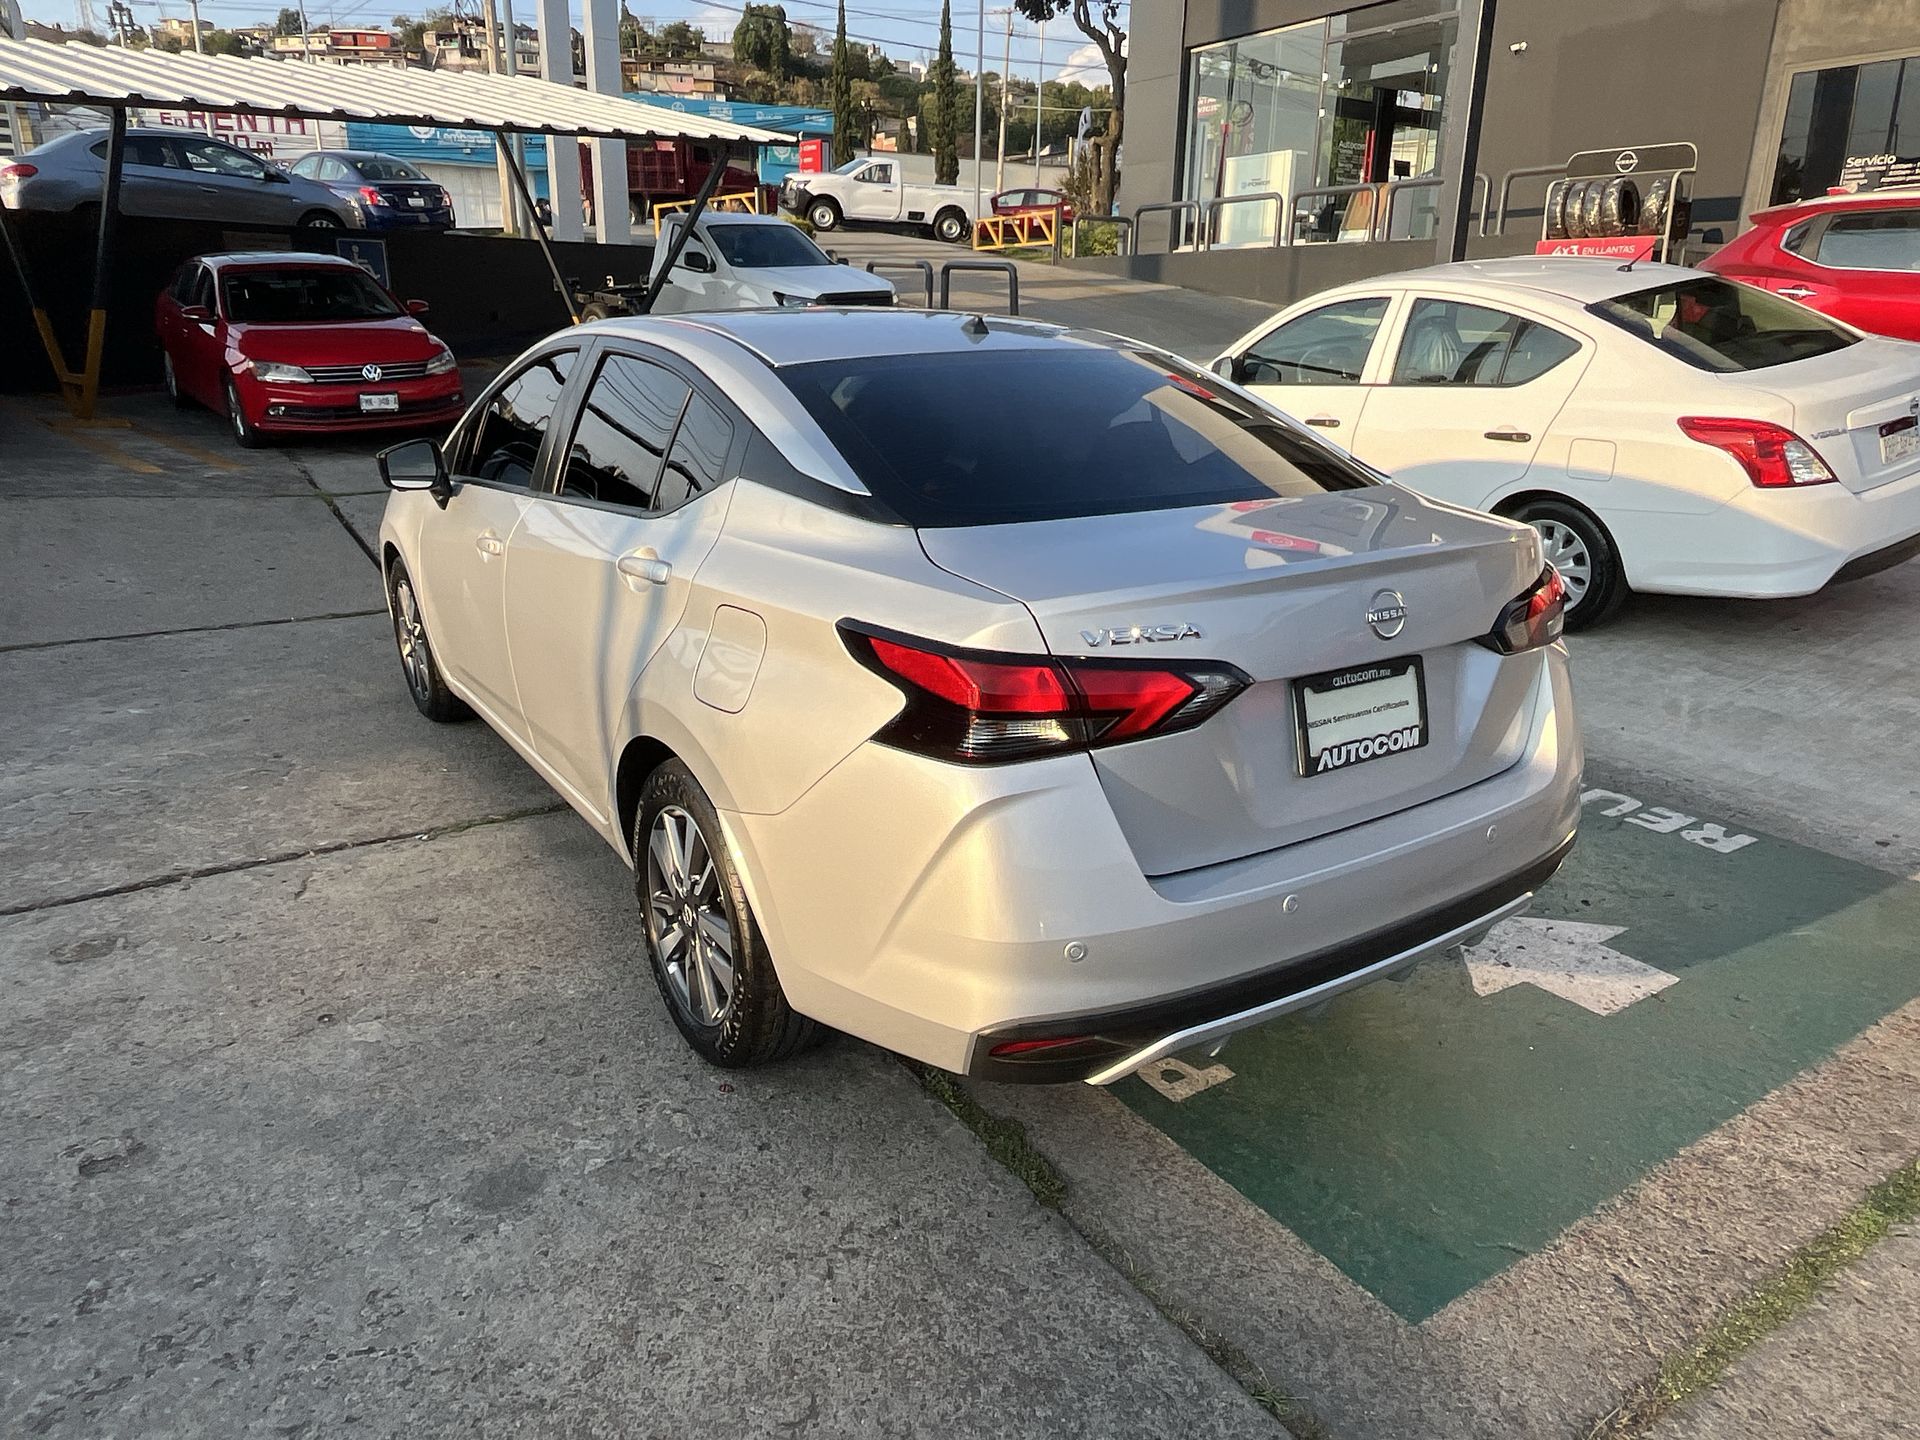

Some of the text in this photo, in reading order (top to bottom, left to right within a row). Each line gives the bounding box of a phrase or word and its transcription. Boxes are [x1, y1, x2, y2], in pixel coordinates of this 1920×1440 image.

[1845, 153, 1897, 168] Servicio
[1581, 247, 1595, 255] EN
[1595, 244, 1635, 255] LLANTAS
[1080, 622, 1202, 647] VERSA
[1317, 727, 1420, 772] AUTOCOM
[1580, 788, 1759, 853] REU
